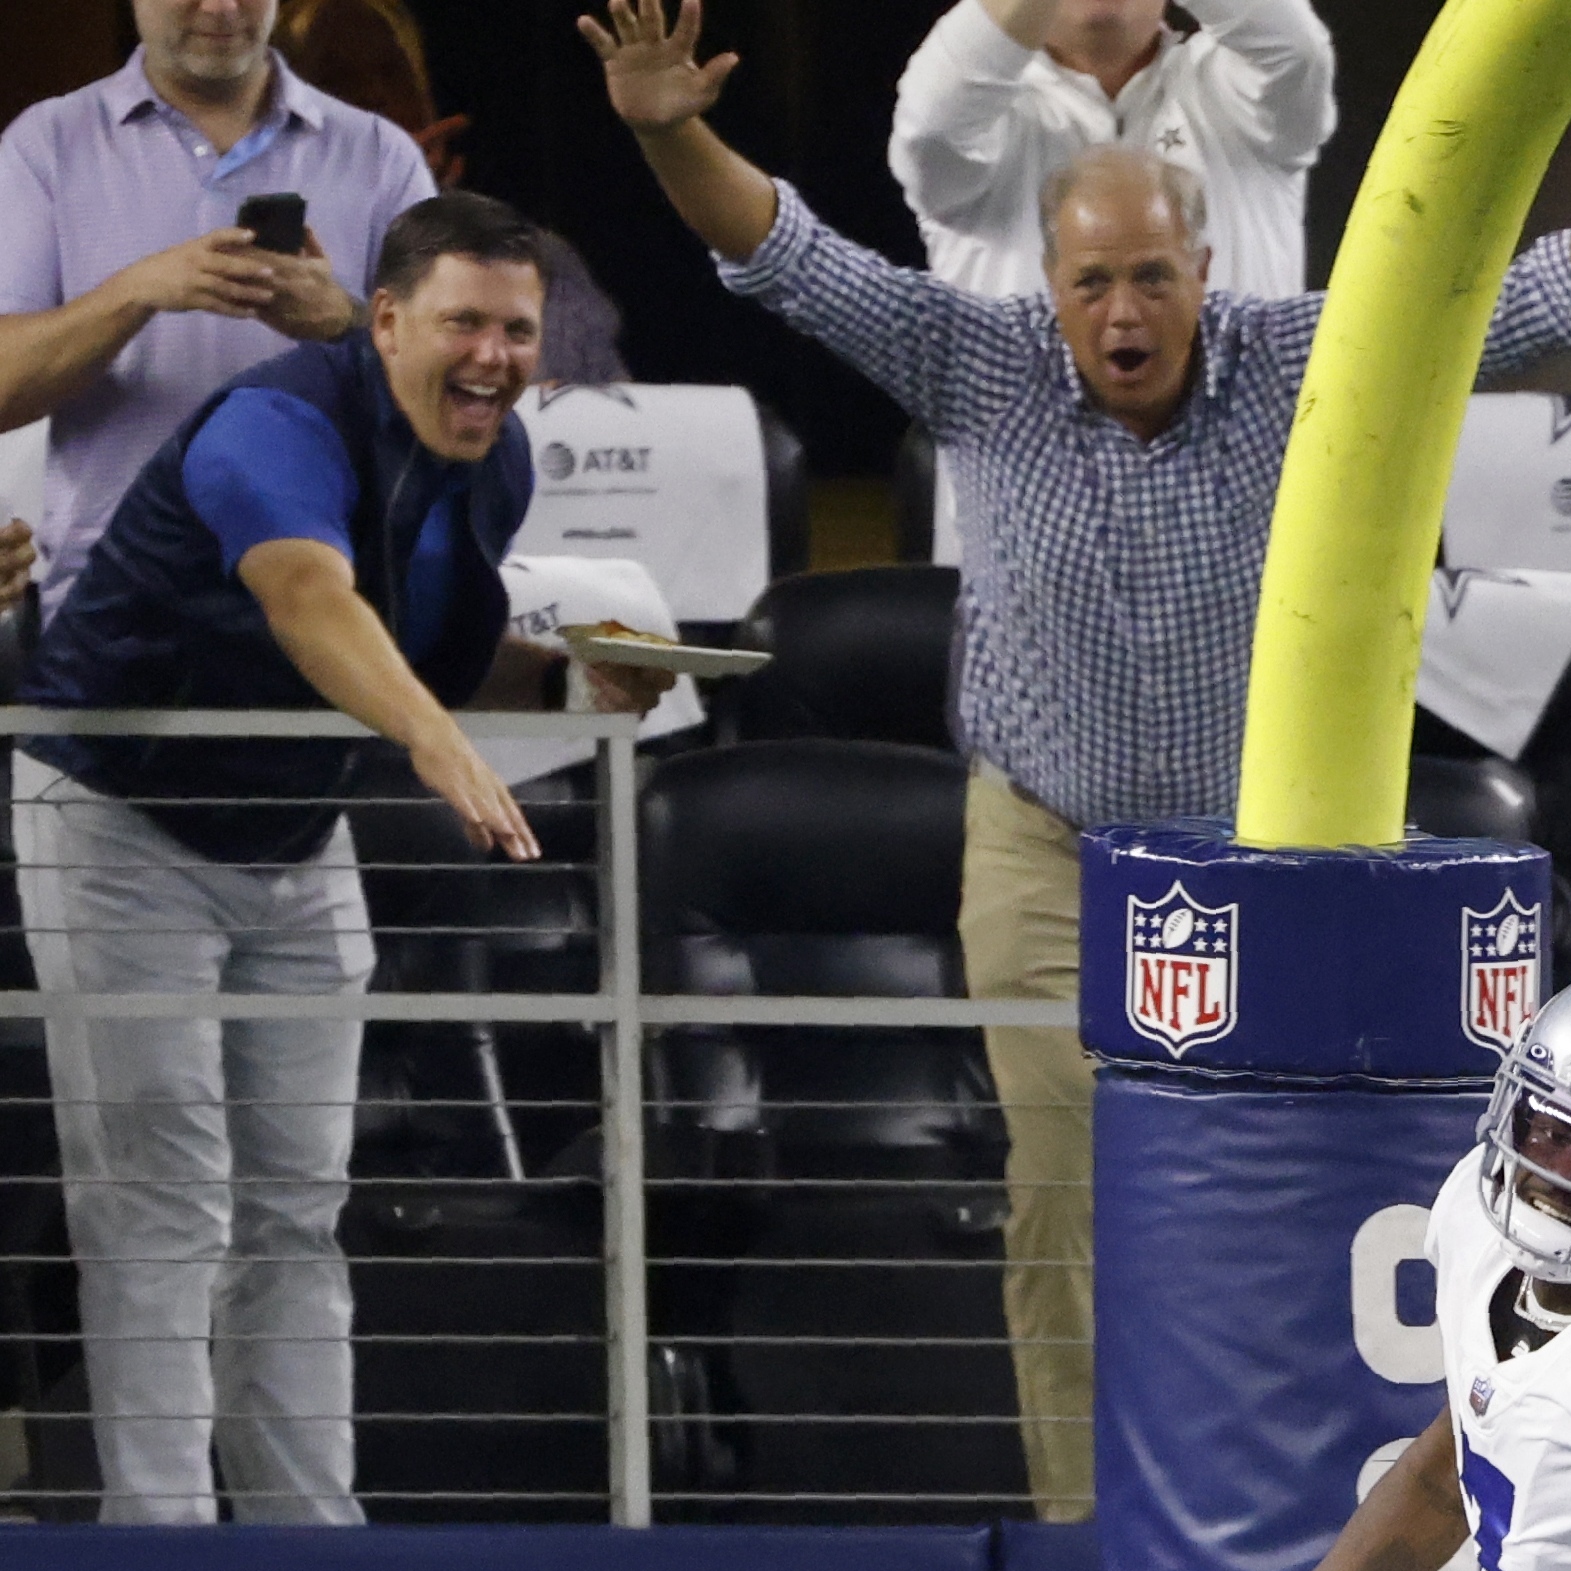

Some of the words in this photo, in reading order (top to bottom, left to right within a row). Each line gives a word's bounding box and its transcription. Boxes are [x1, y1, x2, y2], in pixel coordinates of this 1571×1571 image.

[583, 447, 652, 473] AT&T
[511, 602, 558, 634] T&T
[1139, 957, 1221, 1032] NFL
[1475, 964, 1532, 1036] NFL
